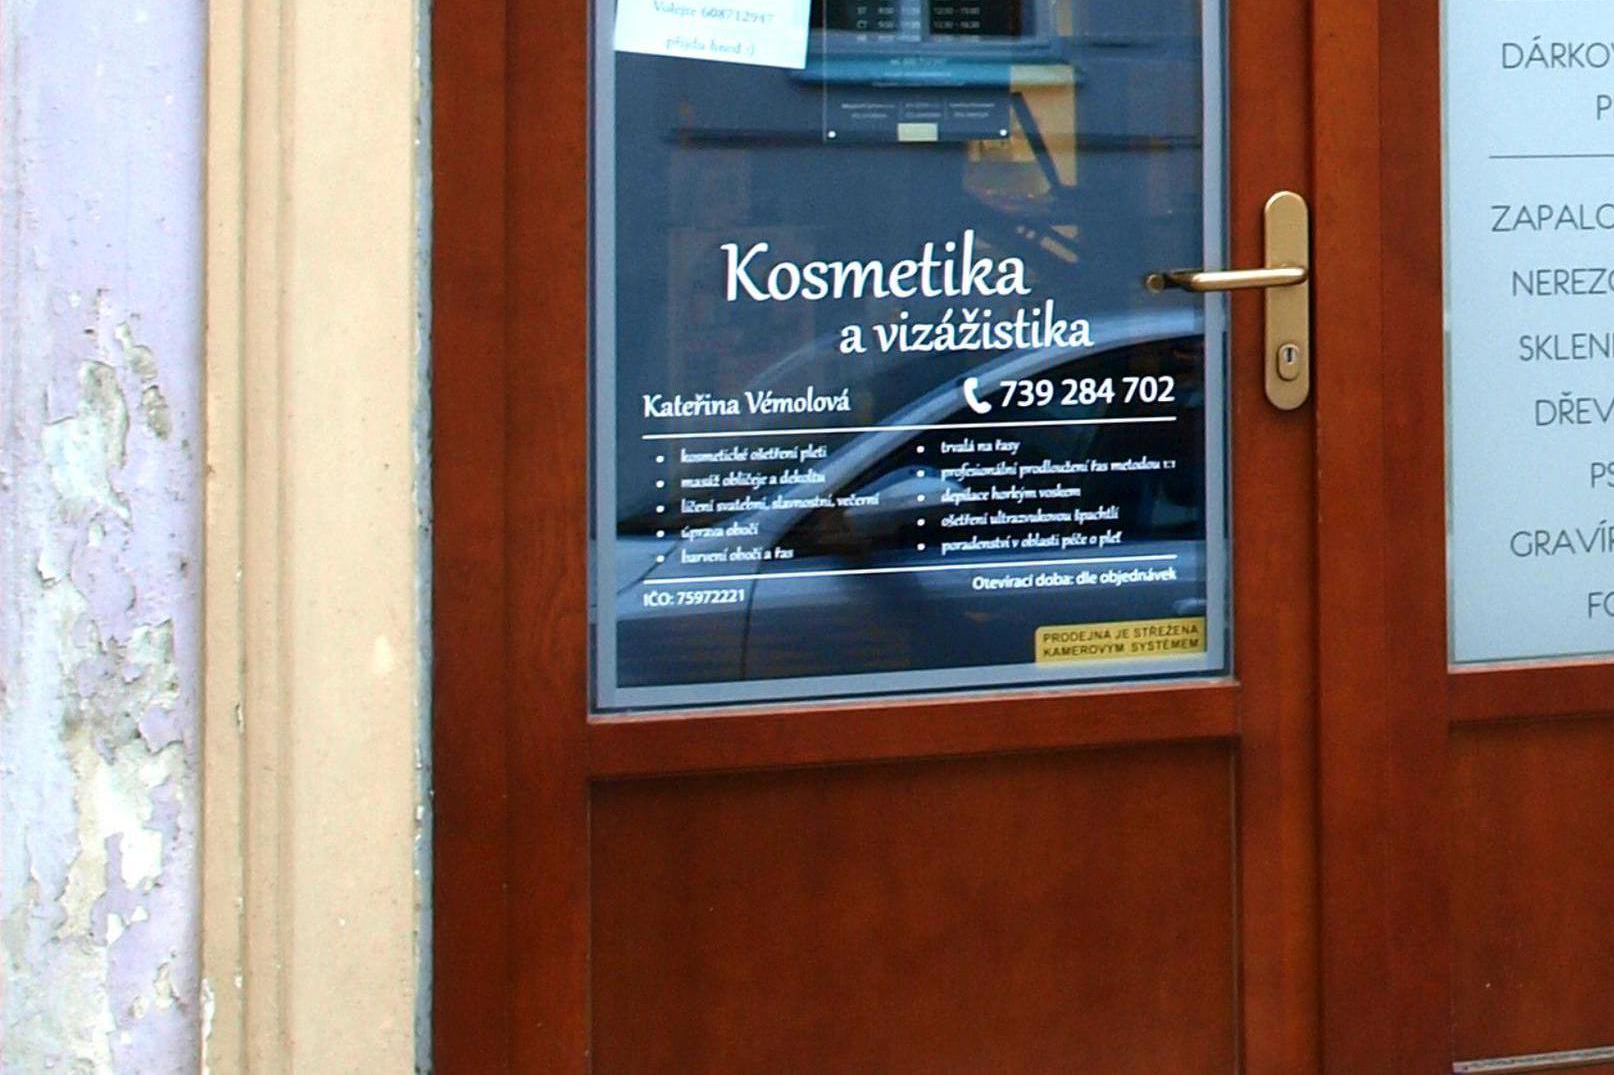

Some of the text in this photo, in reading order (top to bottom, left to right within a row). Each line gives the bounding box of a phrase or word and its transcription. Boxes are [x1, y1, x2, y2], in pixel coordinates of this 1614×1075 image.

[721, 230, 1031, 302] Kosmetika
[840, 299, 1095, 354] a vizážistika
[1000, 376, 1175, 408] 739 284 702
[643, 387, 850, 419] Kateřina Vémolová
[977, 442, 993, 451] na
[764, 551, 772, 559] a
[1035, 570, 1074, 586] doba:
[1076, 569, 1097, 584] dle
[643, 589, 745, 607] IČO: 75972221
[1043, 630, 1110, 643] PRODEJNA
[1116, 629, 1129, 639] JE
